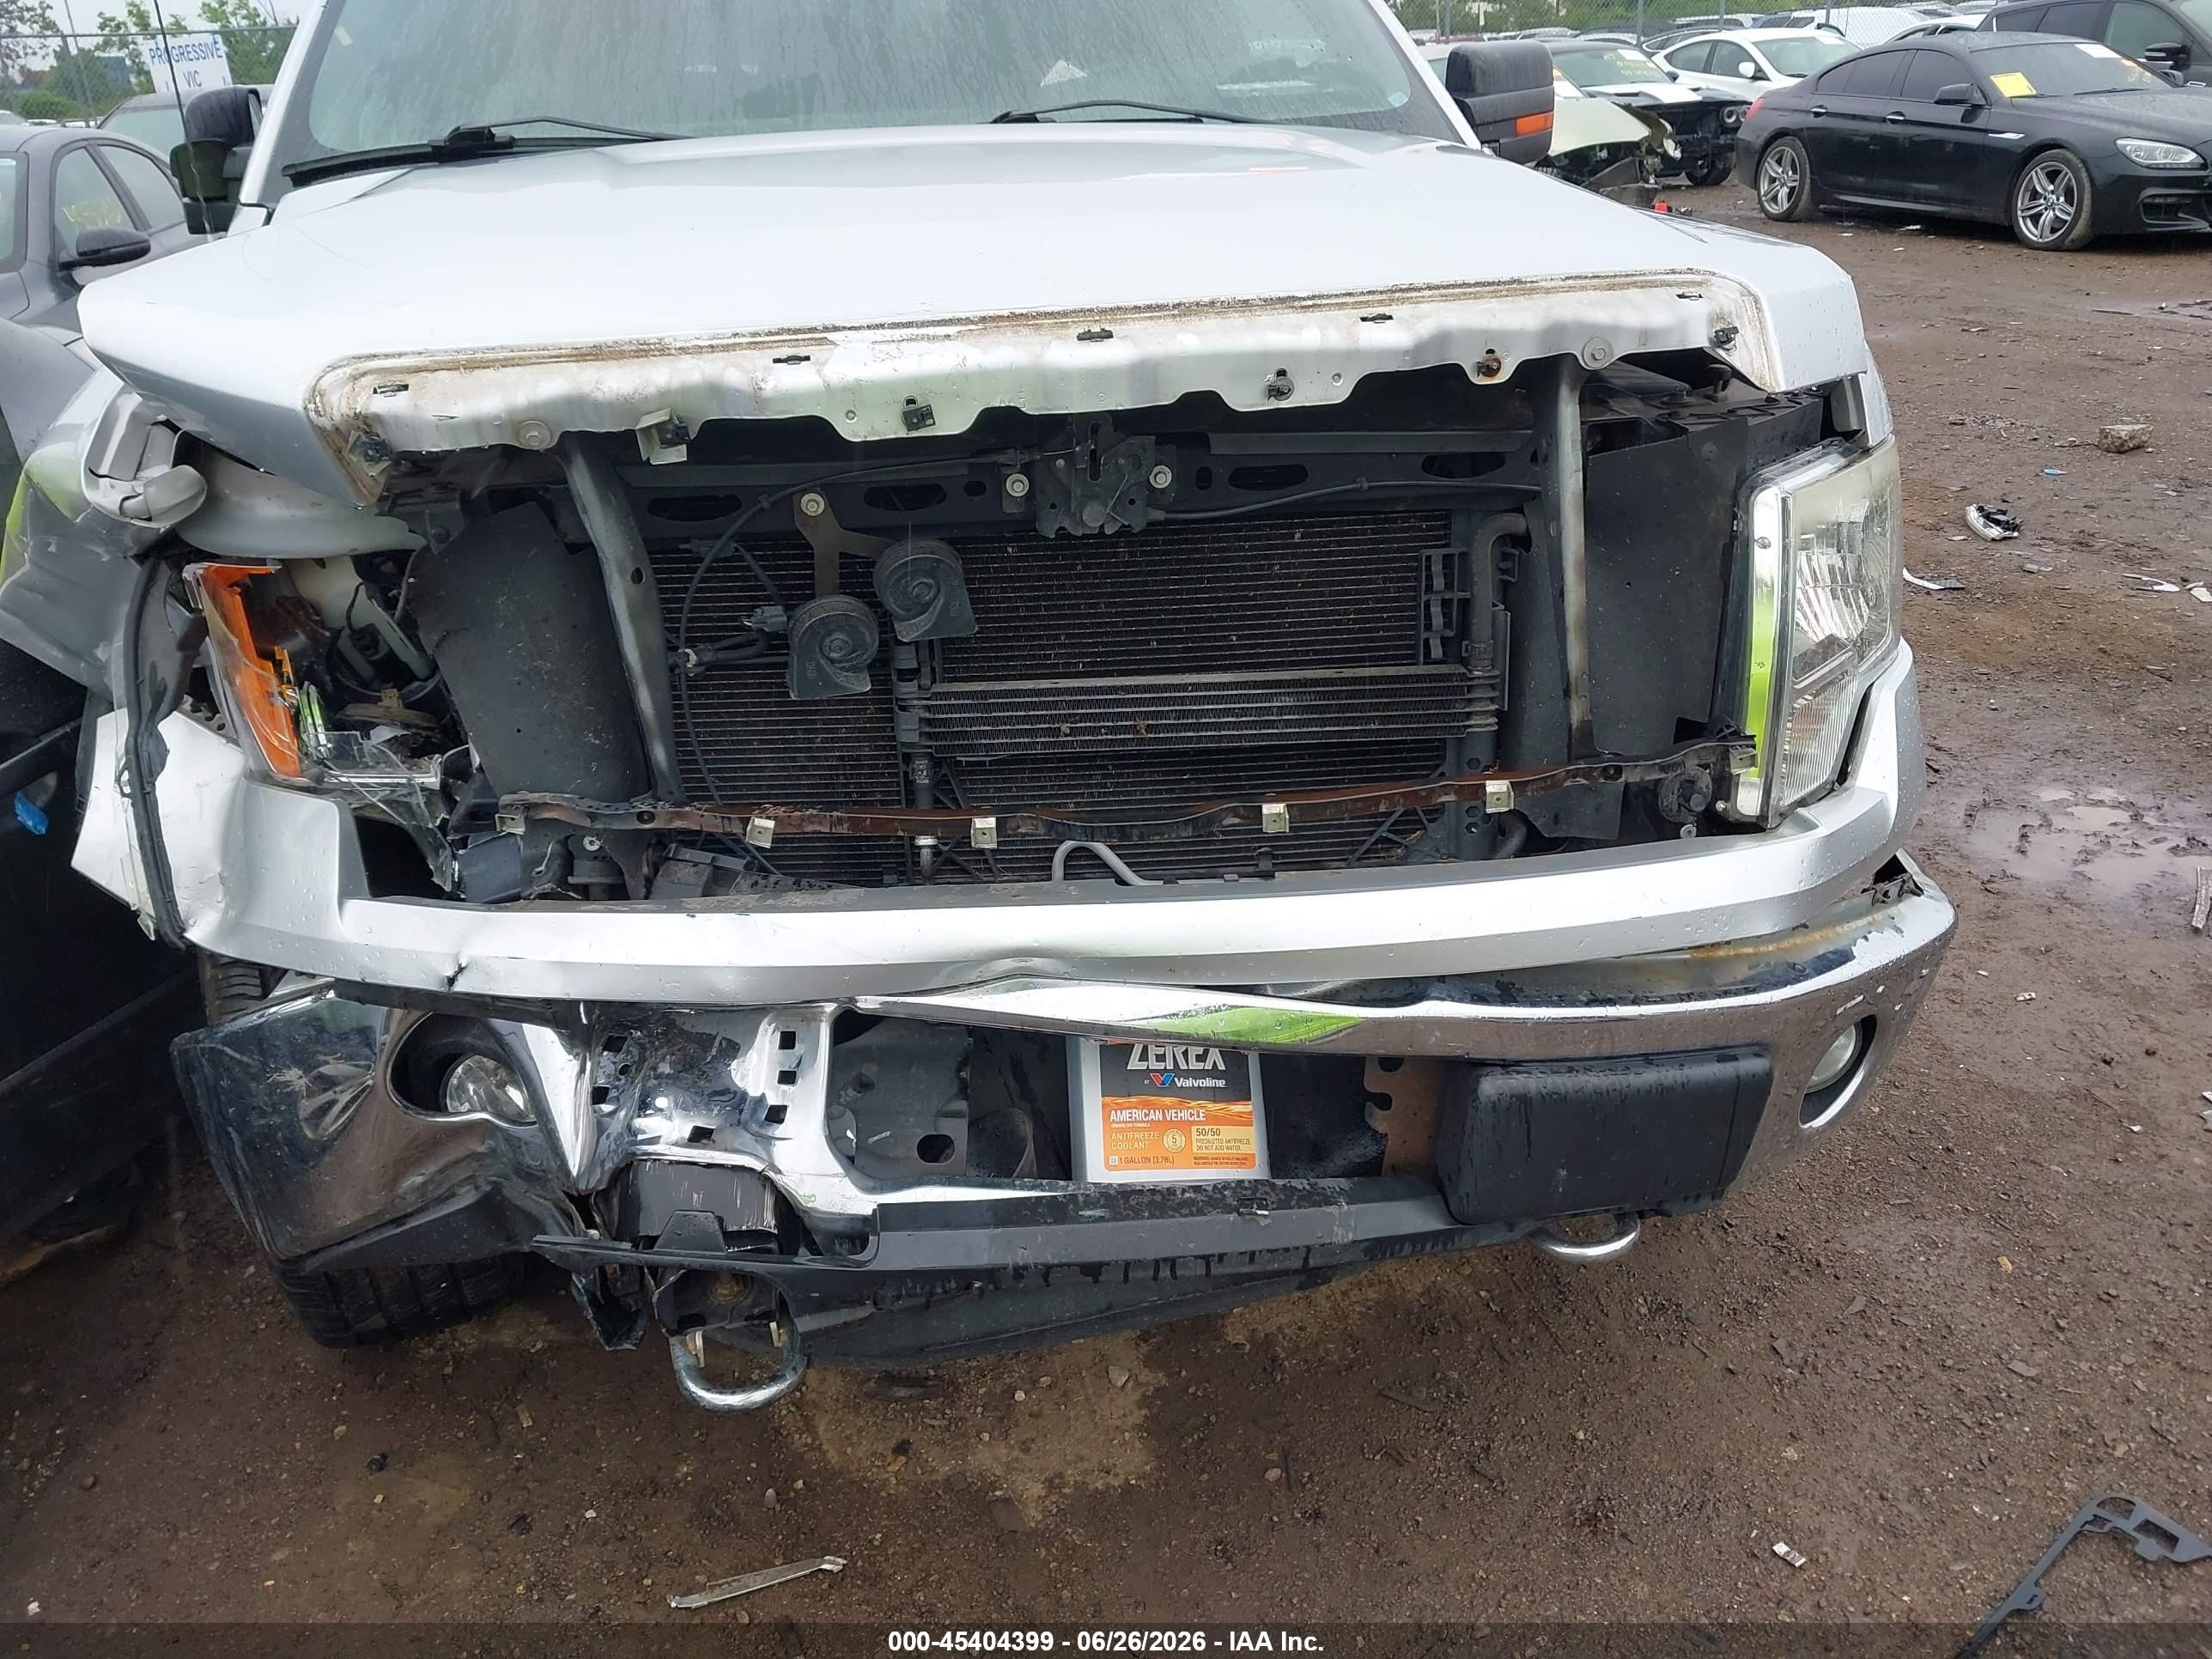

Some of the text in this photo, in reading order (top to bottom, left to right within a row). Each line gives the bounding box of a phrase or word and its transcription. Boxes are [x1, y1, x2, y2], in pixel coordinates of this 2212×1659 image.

[149, 40, 223, 66] PROGRESSIVE
[183, 70, 202, 88] VIC
[1175, 1077, 1227, 1088] Valvoline
[1109, 1109, 1206, 1122] AMERICAN VEHICLE
[1111, 1132, 1159, 1140] ANTIFREEZE
[1195, 1127, 1221, 1137] 50/50
[1171, 1134, 1177, 1144] 5
[1111, 1141, 1150, 1150] COOLANT
[1124, 1156, 1152, 1164] GALLON
